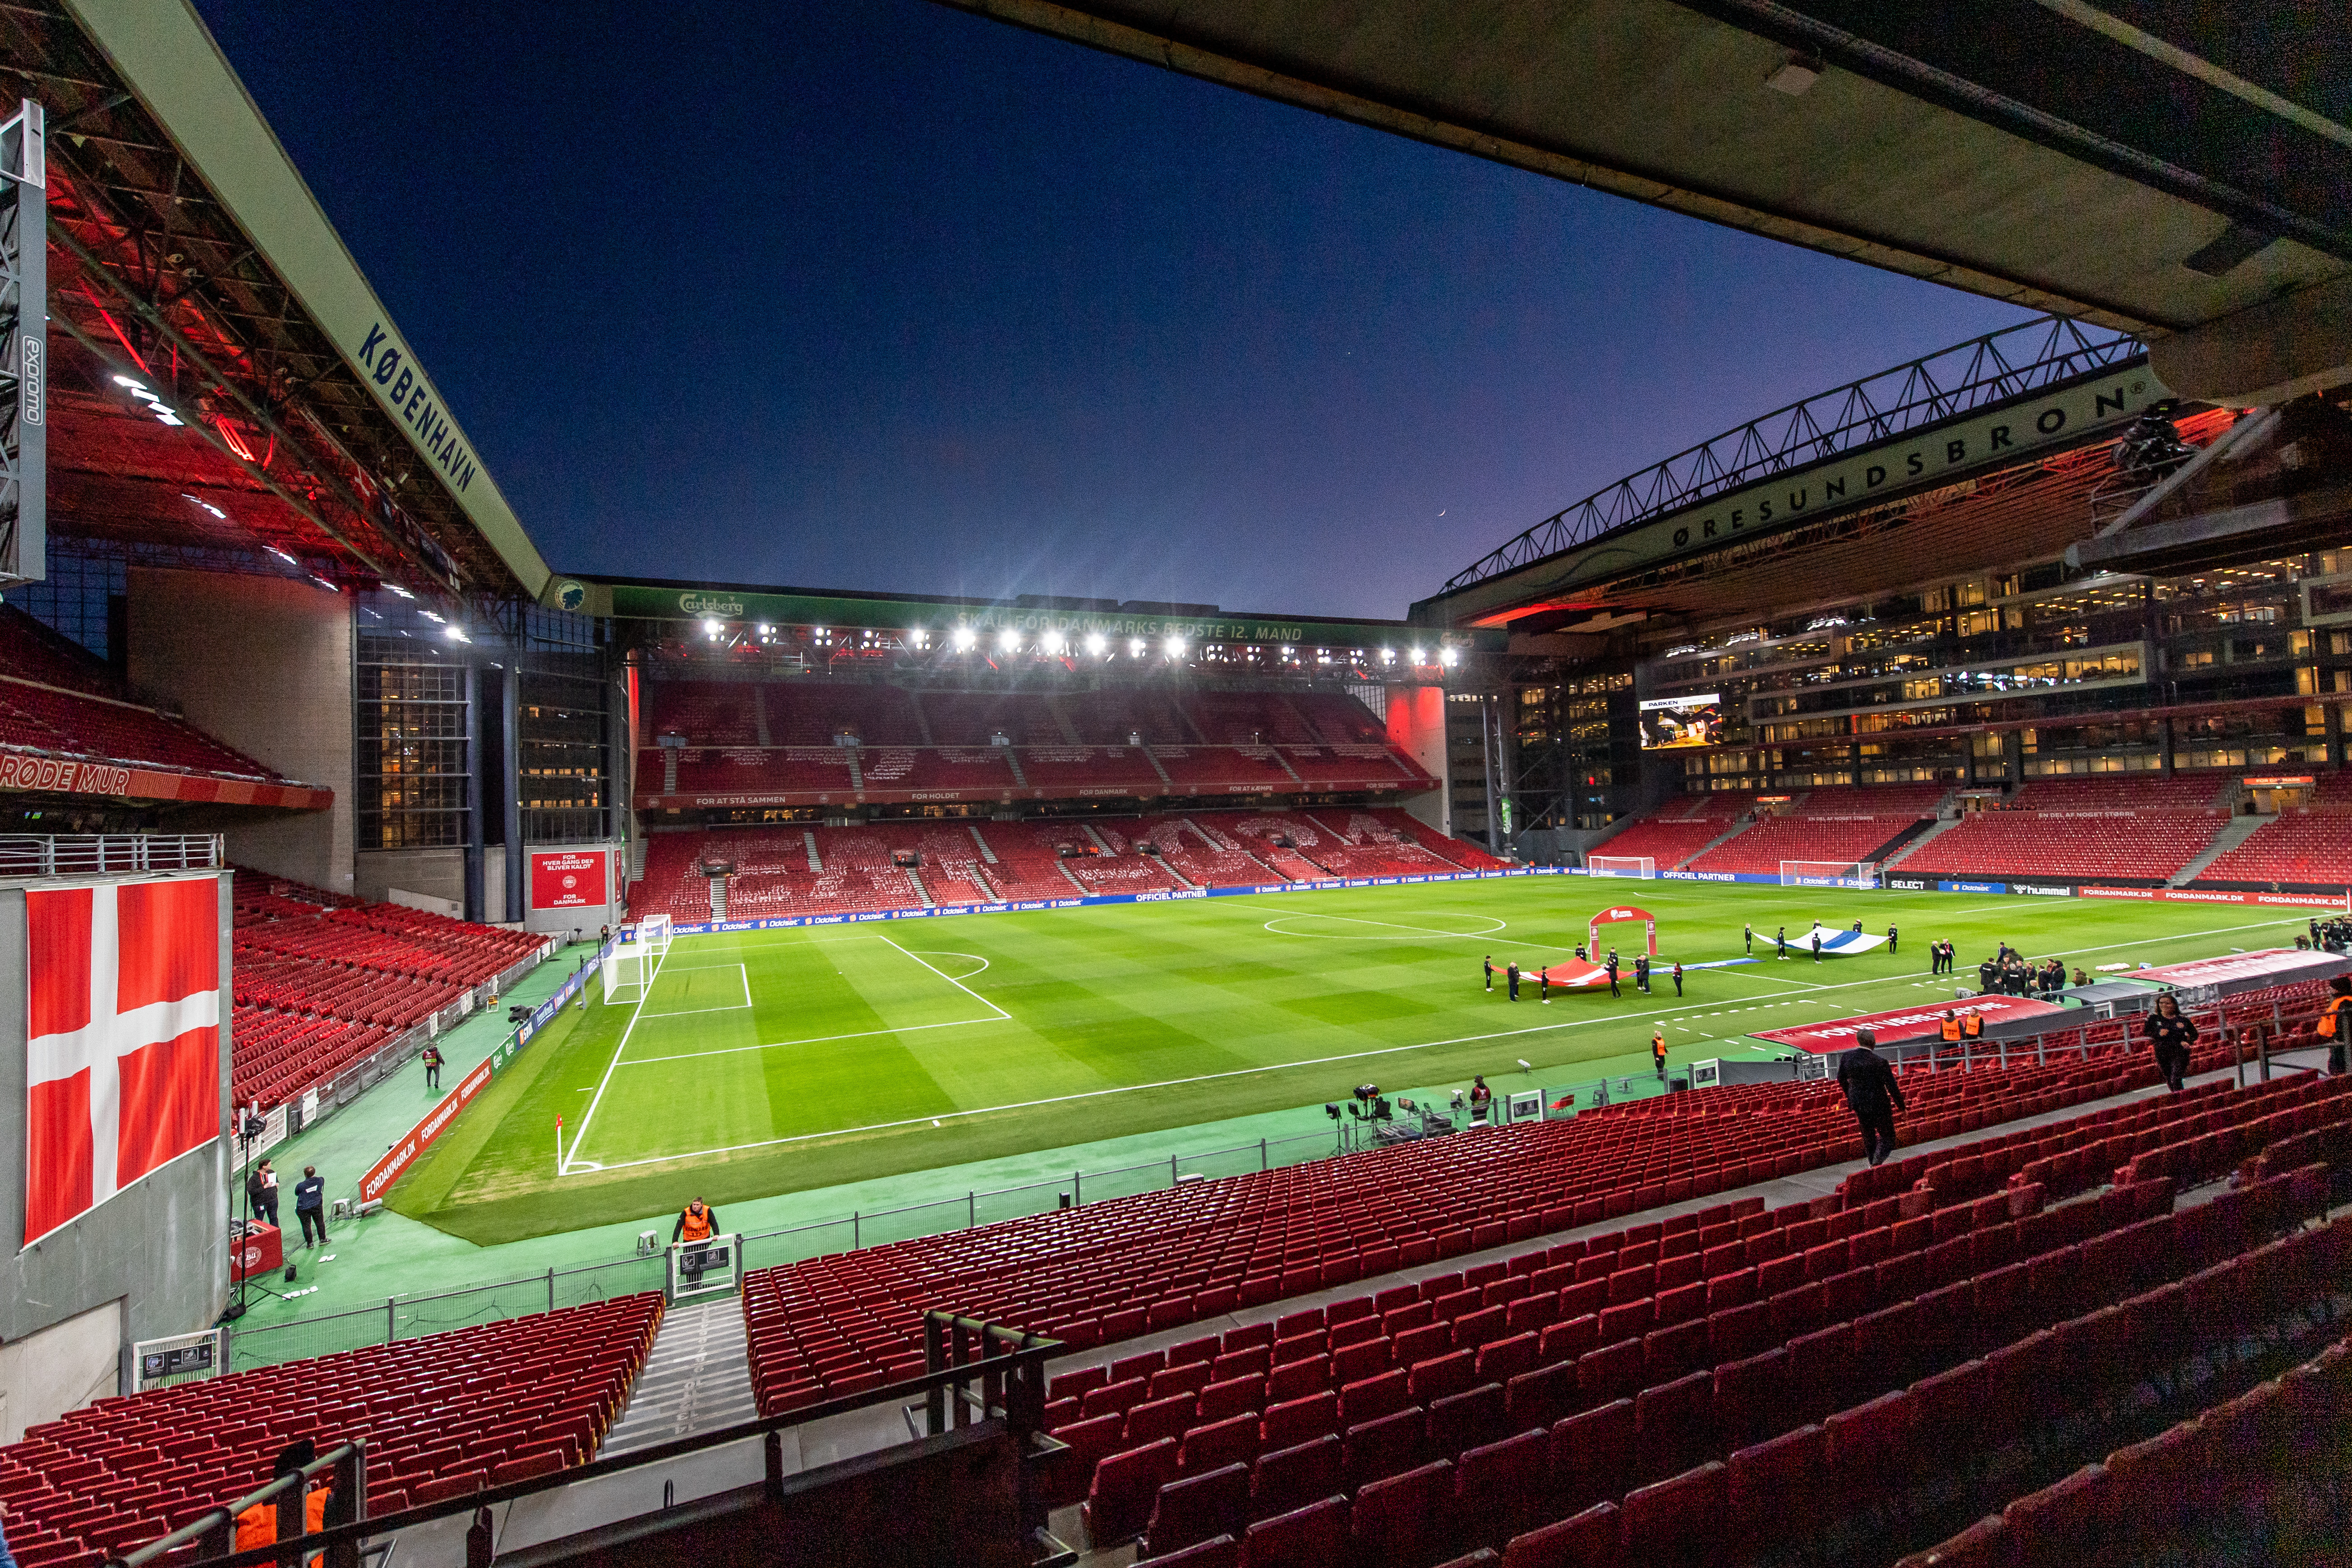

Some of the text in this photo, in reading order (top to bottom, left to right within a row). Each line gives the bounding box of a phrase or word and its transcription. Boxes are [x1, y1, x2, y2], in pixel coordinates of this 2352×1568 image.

[25, 340, 40, 422] expromo
[358, 322, 476, 493] KØBENHAVN
[679, 593, 743, 617] Carlsberg
[1015, 614, 1050, 631] FOR
[1058, 617, 1157, 635] DANMARKS
[1163, 622, 1225, 638] BEDSTE
[1255, 627, 1302, 641] MAND
[0, 755, 130, 795] RØDE MUR
[729, 796, 746, 804] STÅ
[1663, 871, 1735, 882] OFFICIEL PARTNER
[1803, 877, 1831, 885] Oddset
[1891, 880, 1924, 890] SELECT
[1136, 890, 1207, 902] OFFICIEL PARTNER
[2027, 885, 2070, 896] hummel
[2083, 889, 2347, 906] FORDANMARK.DK FORDANMARK.DK FORDANMARK.DK
[673, 925, 704, 934] Oddset
[722, 923, 753, 931] Oddset
[769, 919, 798, 927] Oddset
[1808, 1027, 1858, 1038] FOR
[1852, 1022, 1885, 1030] AT
[1874, 1014, 1940, 1027] VÆRE
[461, 1065, 490, 1101] FORDANMARK.DK
[421, 1097, 458, 1143] FORDANMARK.DK
[366, 1139, 416, 1200] FORDANMARK.DK
